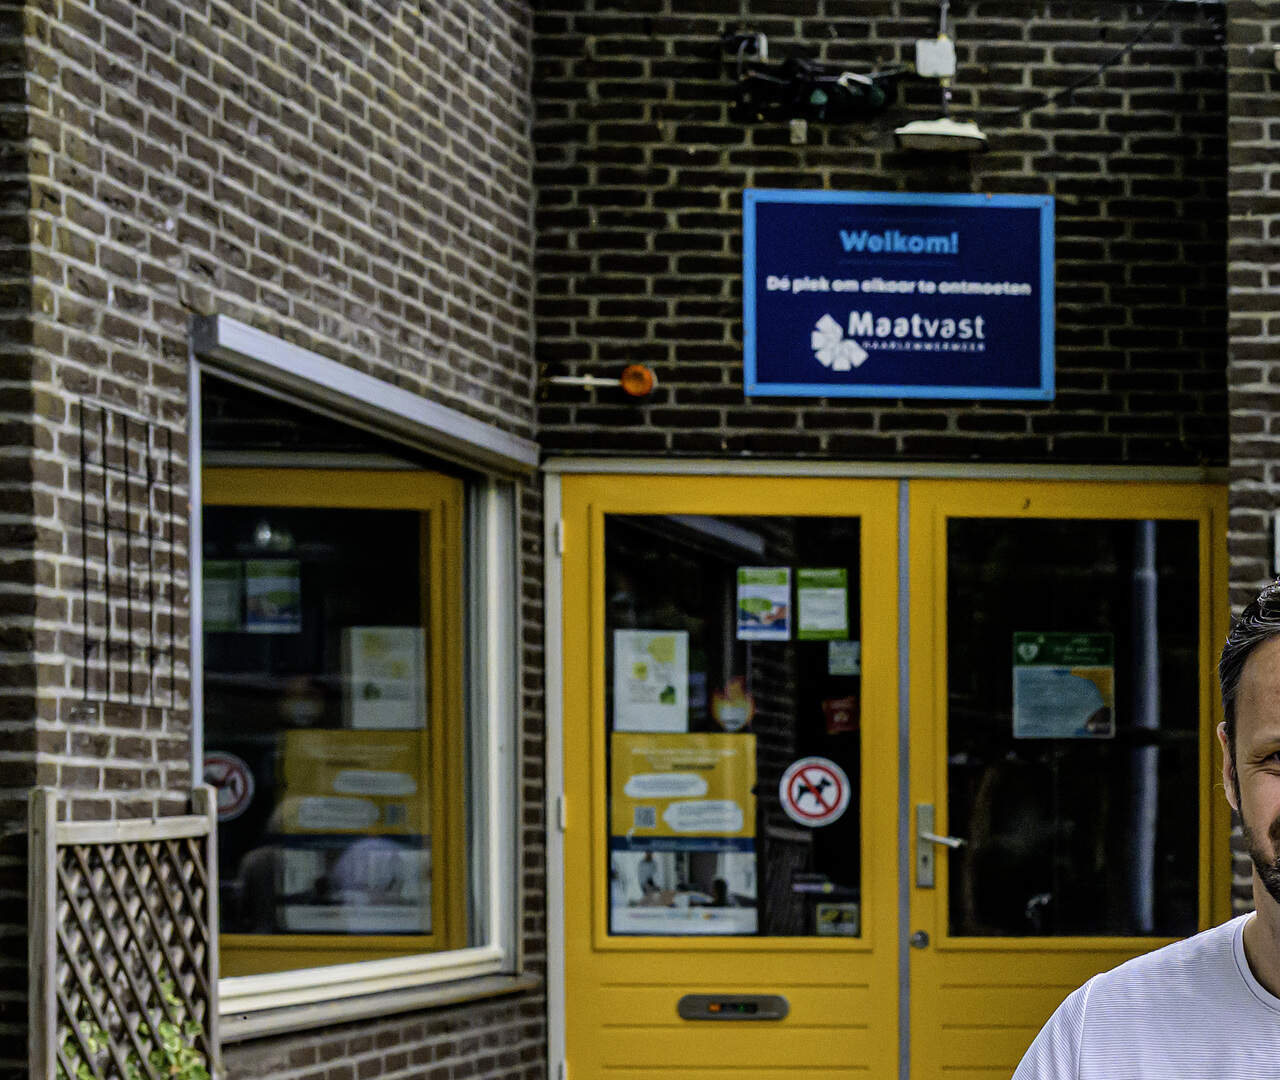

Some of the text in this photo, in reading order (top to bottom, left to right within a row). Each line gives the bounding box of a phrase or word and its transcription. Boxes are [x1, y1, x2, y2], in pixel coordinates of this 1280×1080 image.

[840, 230, 959, 254] Welkom!
[831, 278, 859, 292] om
[860, 277, 917, 293] elkaar
[917, 278, 937, 294] te
[938, 279, 1033, 296] ontmoeten
[847, 309, 986, 340] Maatvast
